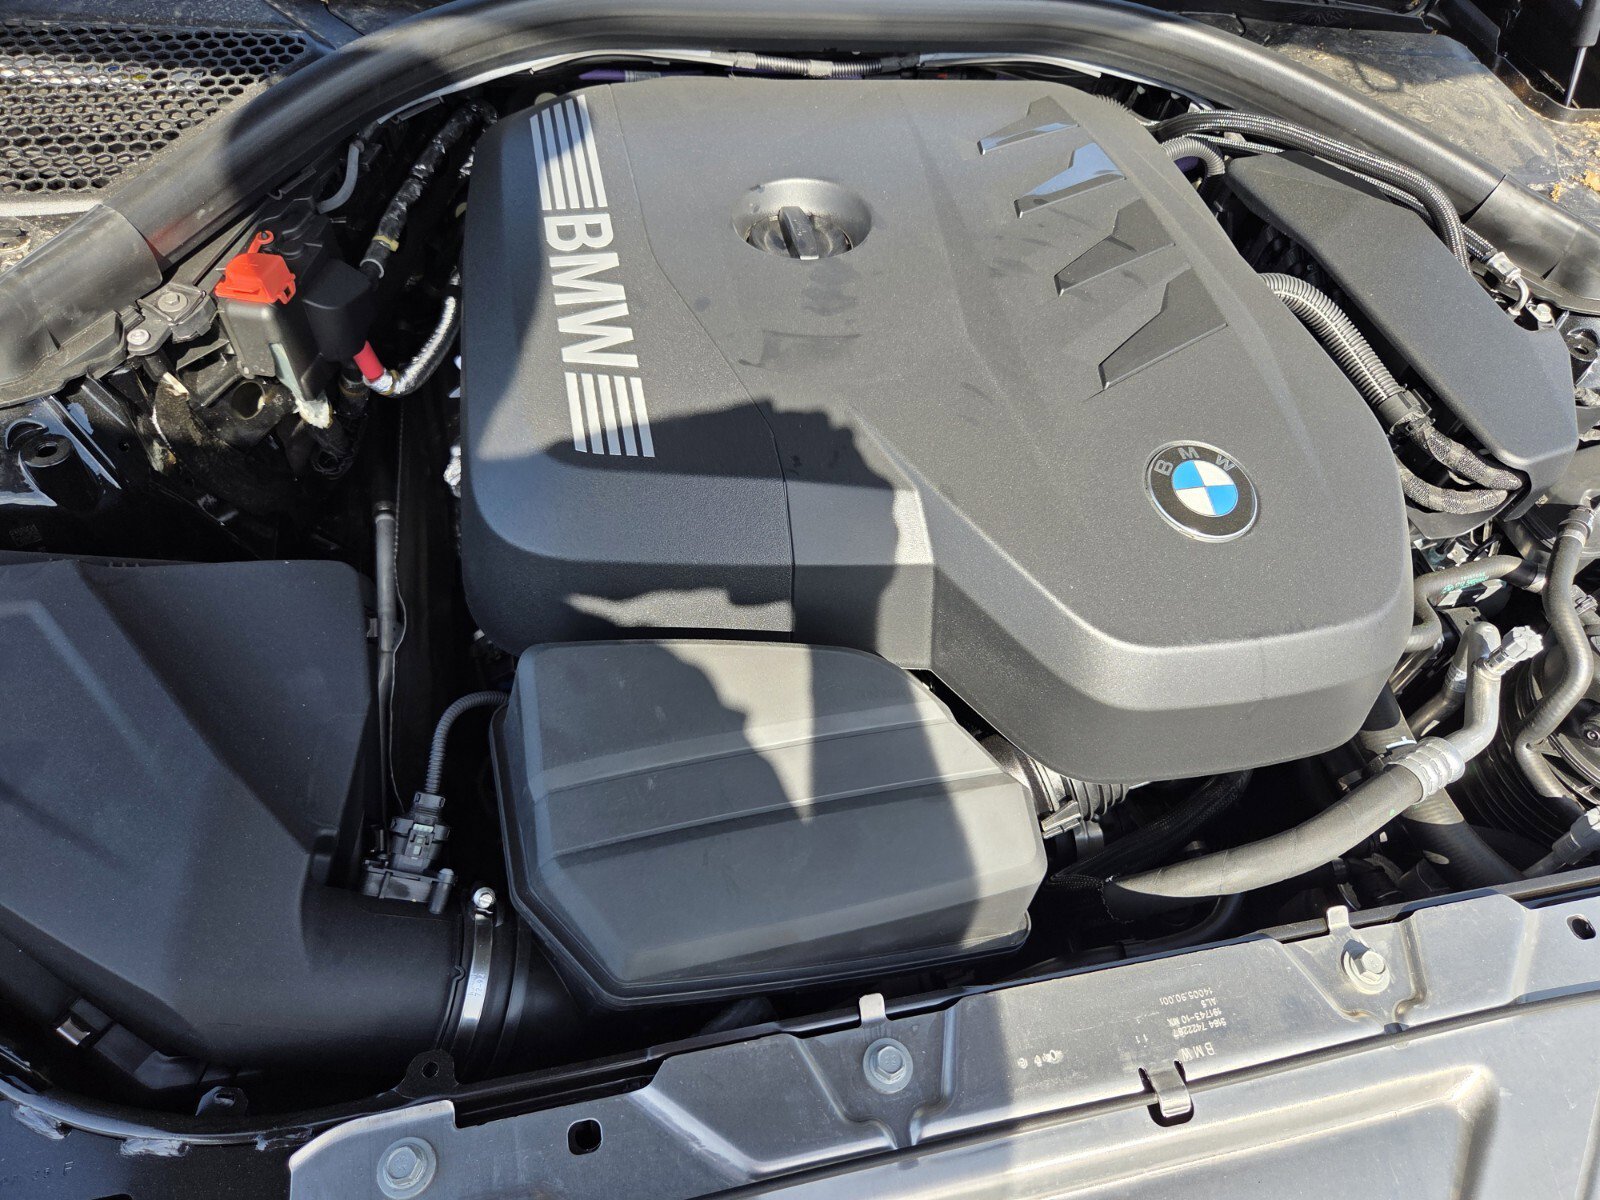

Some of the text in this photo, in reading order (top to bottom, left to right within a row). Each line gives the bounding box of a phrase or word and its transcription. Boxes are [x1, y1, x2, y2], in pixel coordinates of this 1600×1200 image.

[543, 213, 639, 368] BMW
[1153, 446, 1236, 476] BMW
[1179, 1041, 1215, 1061] BMW
